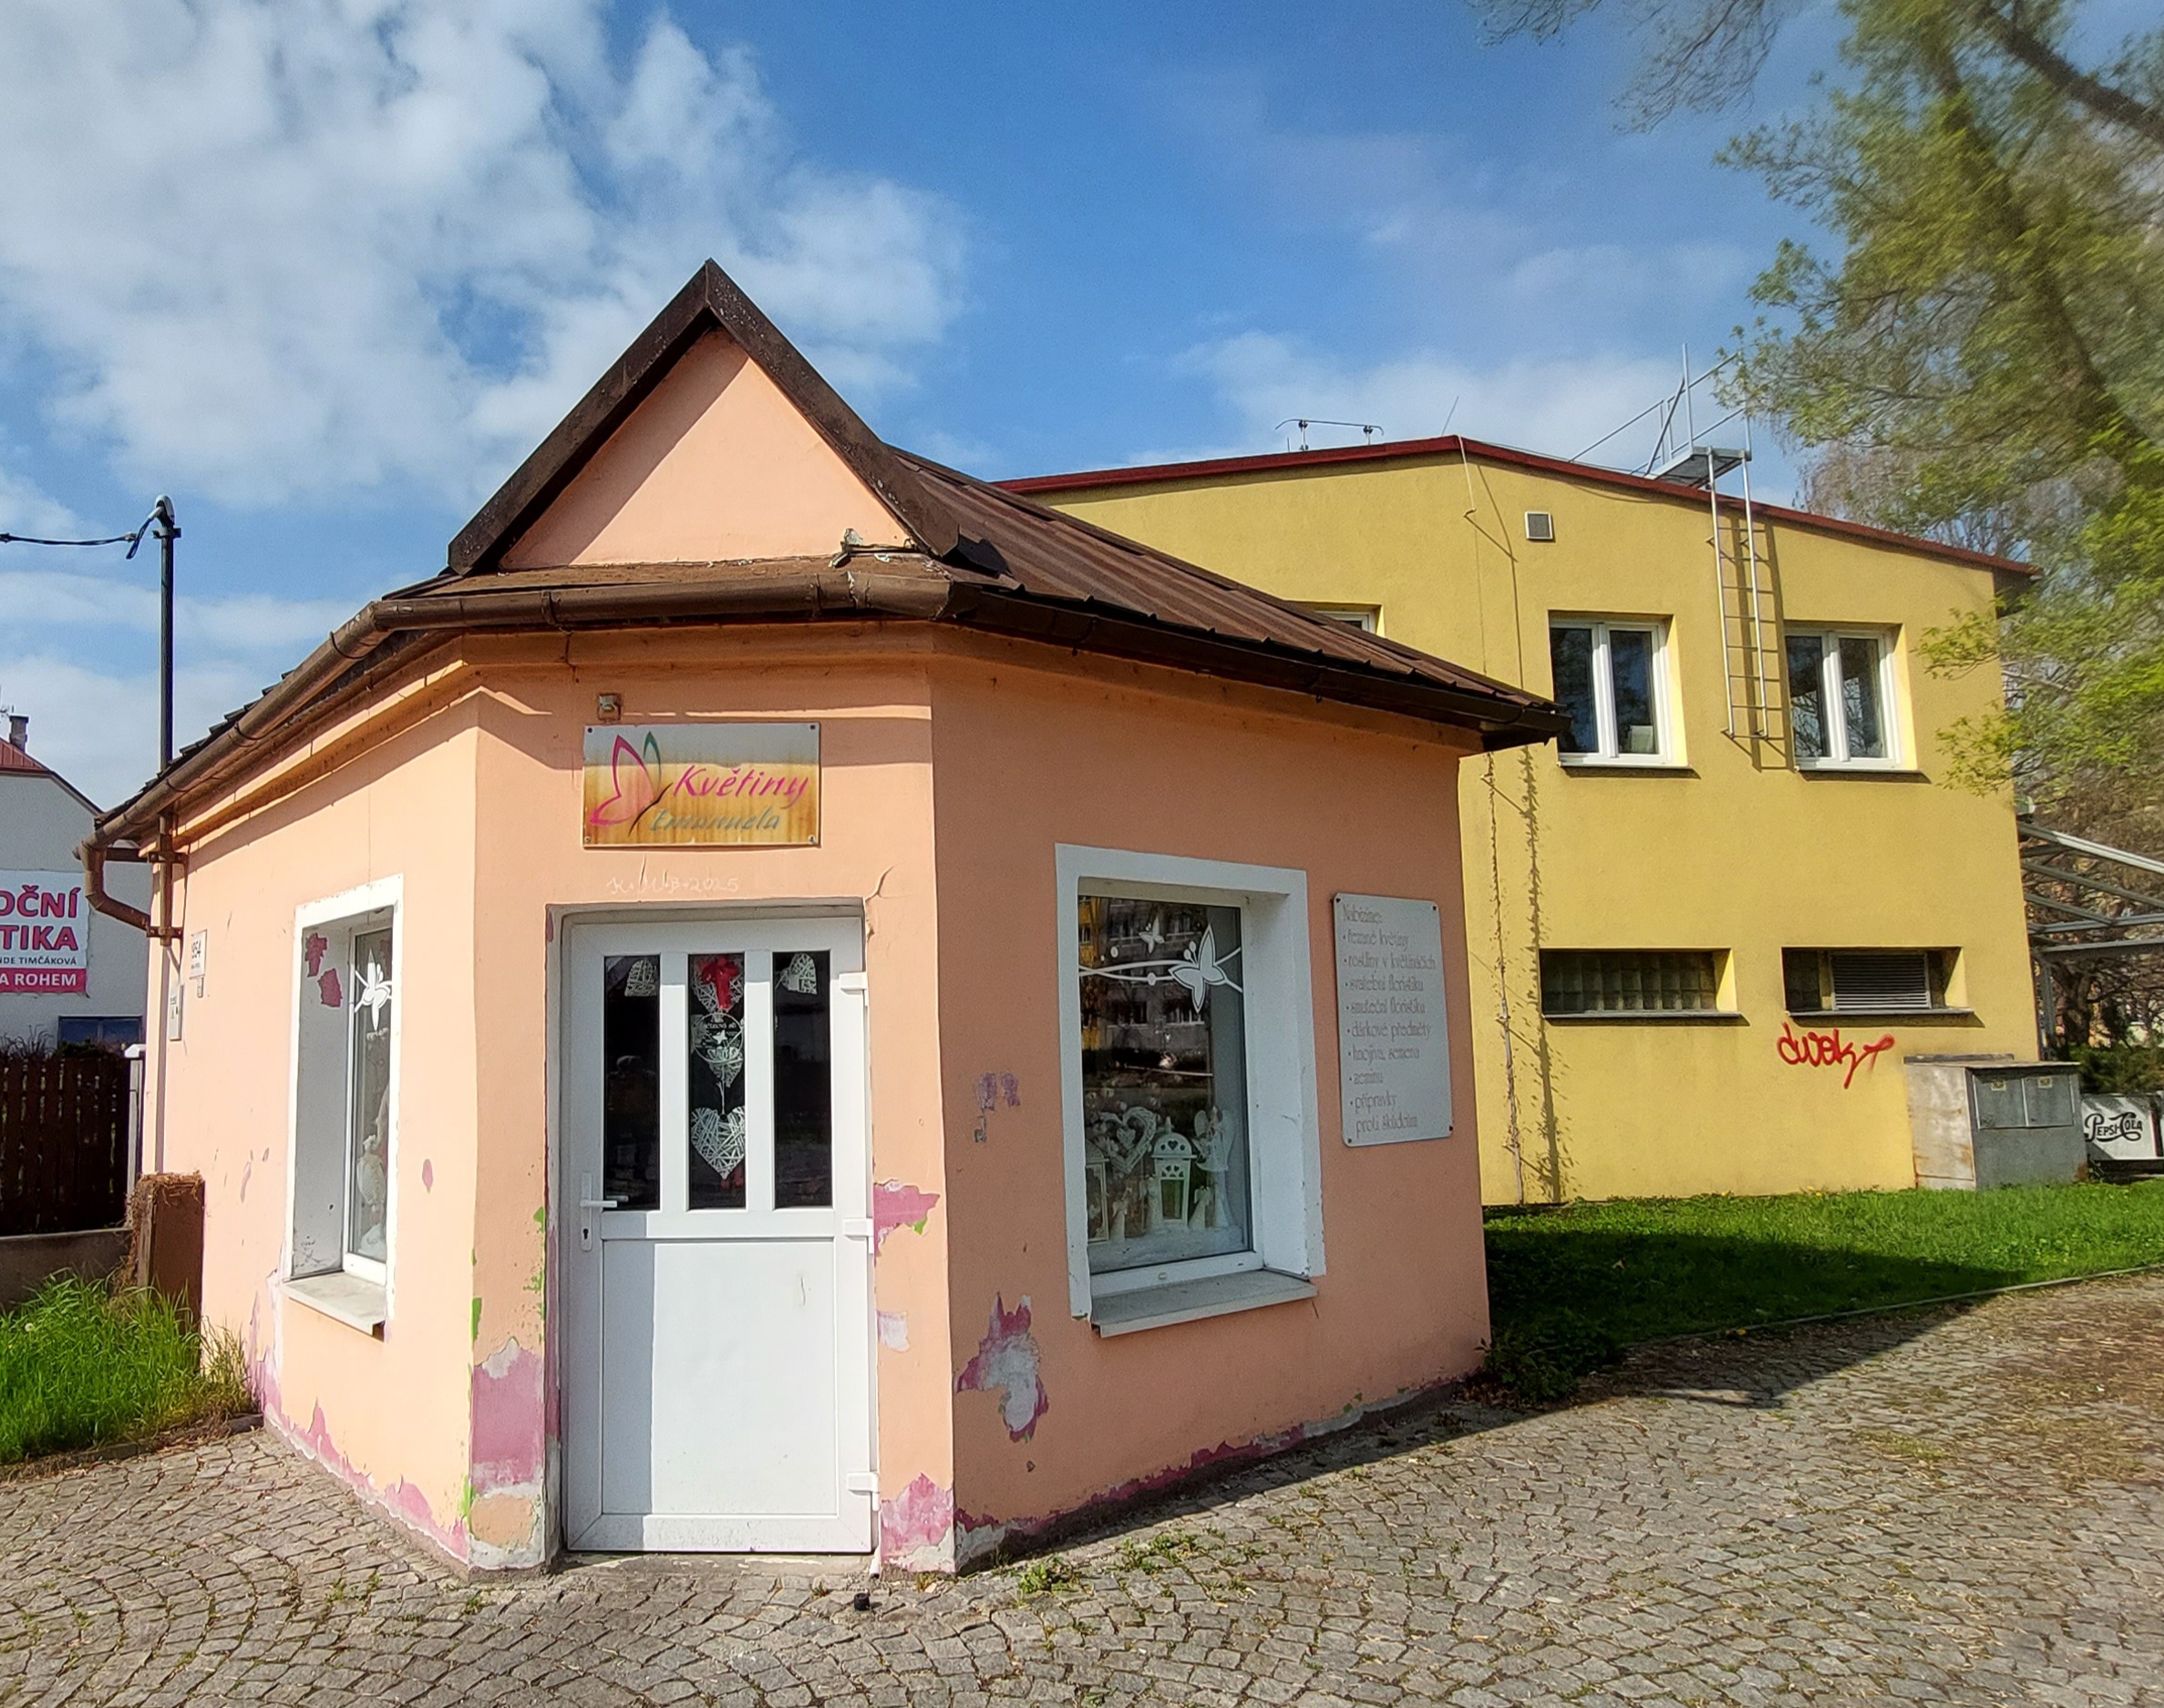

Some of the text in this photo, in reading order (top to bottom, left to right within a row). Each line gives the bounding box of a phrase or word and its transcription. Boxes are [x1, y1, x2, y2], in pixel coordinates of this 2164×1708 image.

[673, 765, 809, 809] Květiny
[649, 807, 780, 832] Emanuela
[0, 955, 77, 965] DE TIMČÁKOVÁ
[15, 973, 77, 986] ROHEM
